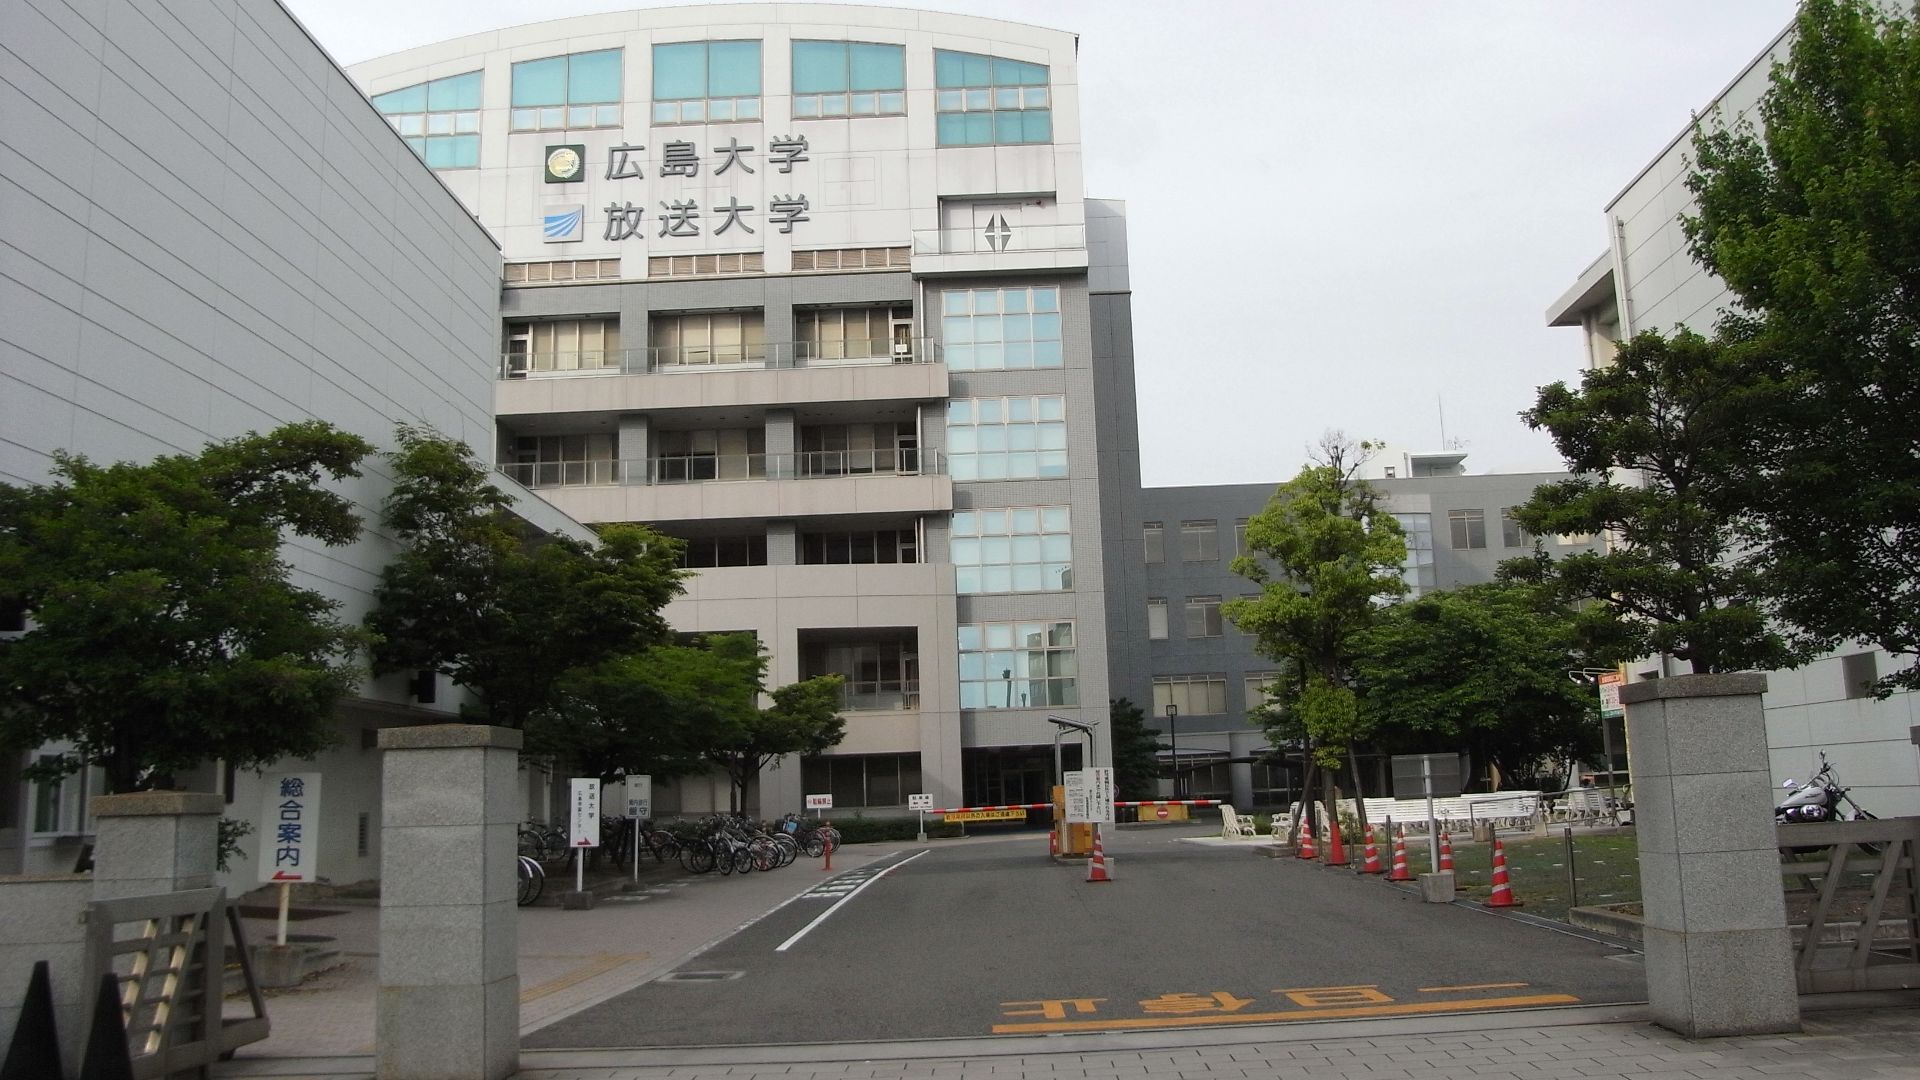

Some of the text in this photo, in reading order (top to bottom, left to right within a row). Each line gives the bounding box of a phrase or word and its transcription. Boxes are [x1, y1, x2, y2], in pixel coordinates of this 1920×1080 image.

[604, 135, 809, 180] 広島大学
[603, 194, 810, 240] 放送大学
[276, 777, 304, 867] 総合案内
